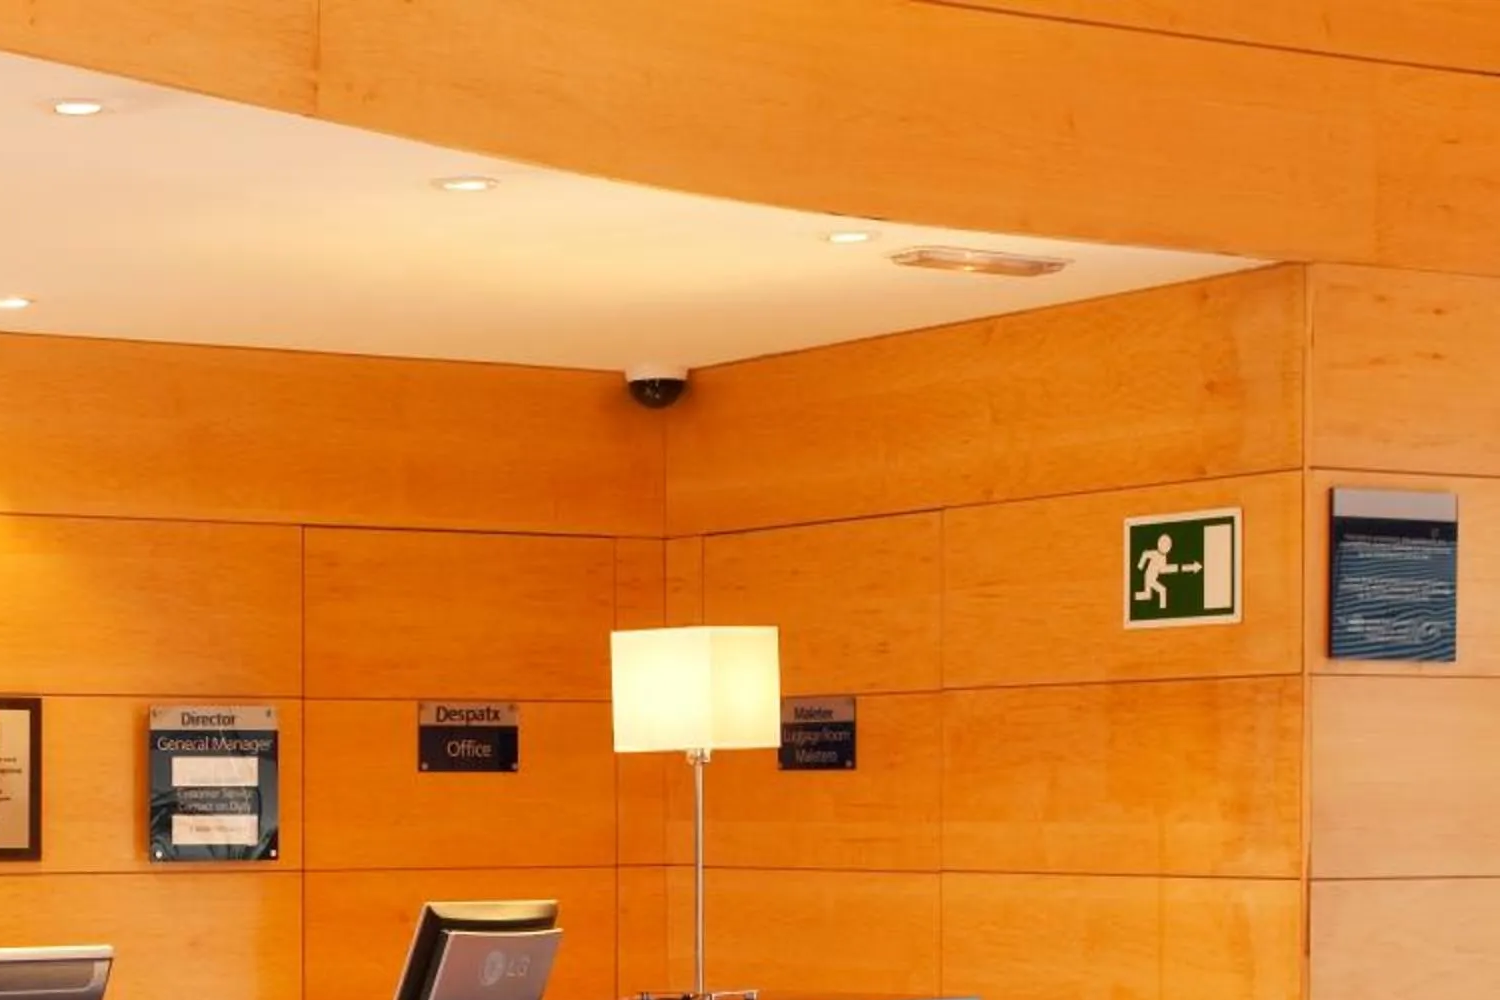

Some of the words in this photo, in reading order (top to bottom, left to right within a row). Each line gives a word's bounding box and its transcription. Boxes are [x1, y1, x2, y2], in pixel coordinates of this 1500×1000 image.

[180, 711, 236, 727] Director
[436, 704, 501, 725] Despatx
[156, 736, 209, 751] General
[211, 737, 273, 753] Manager
[446, 739, 493, 757] Office
